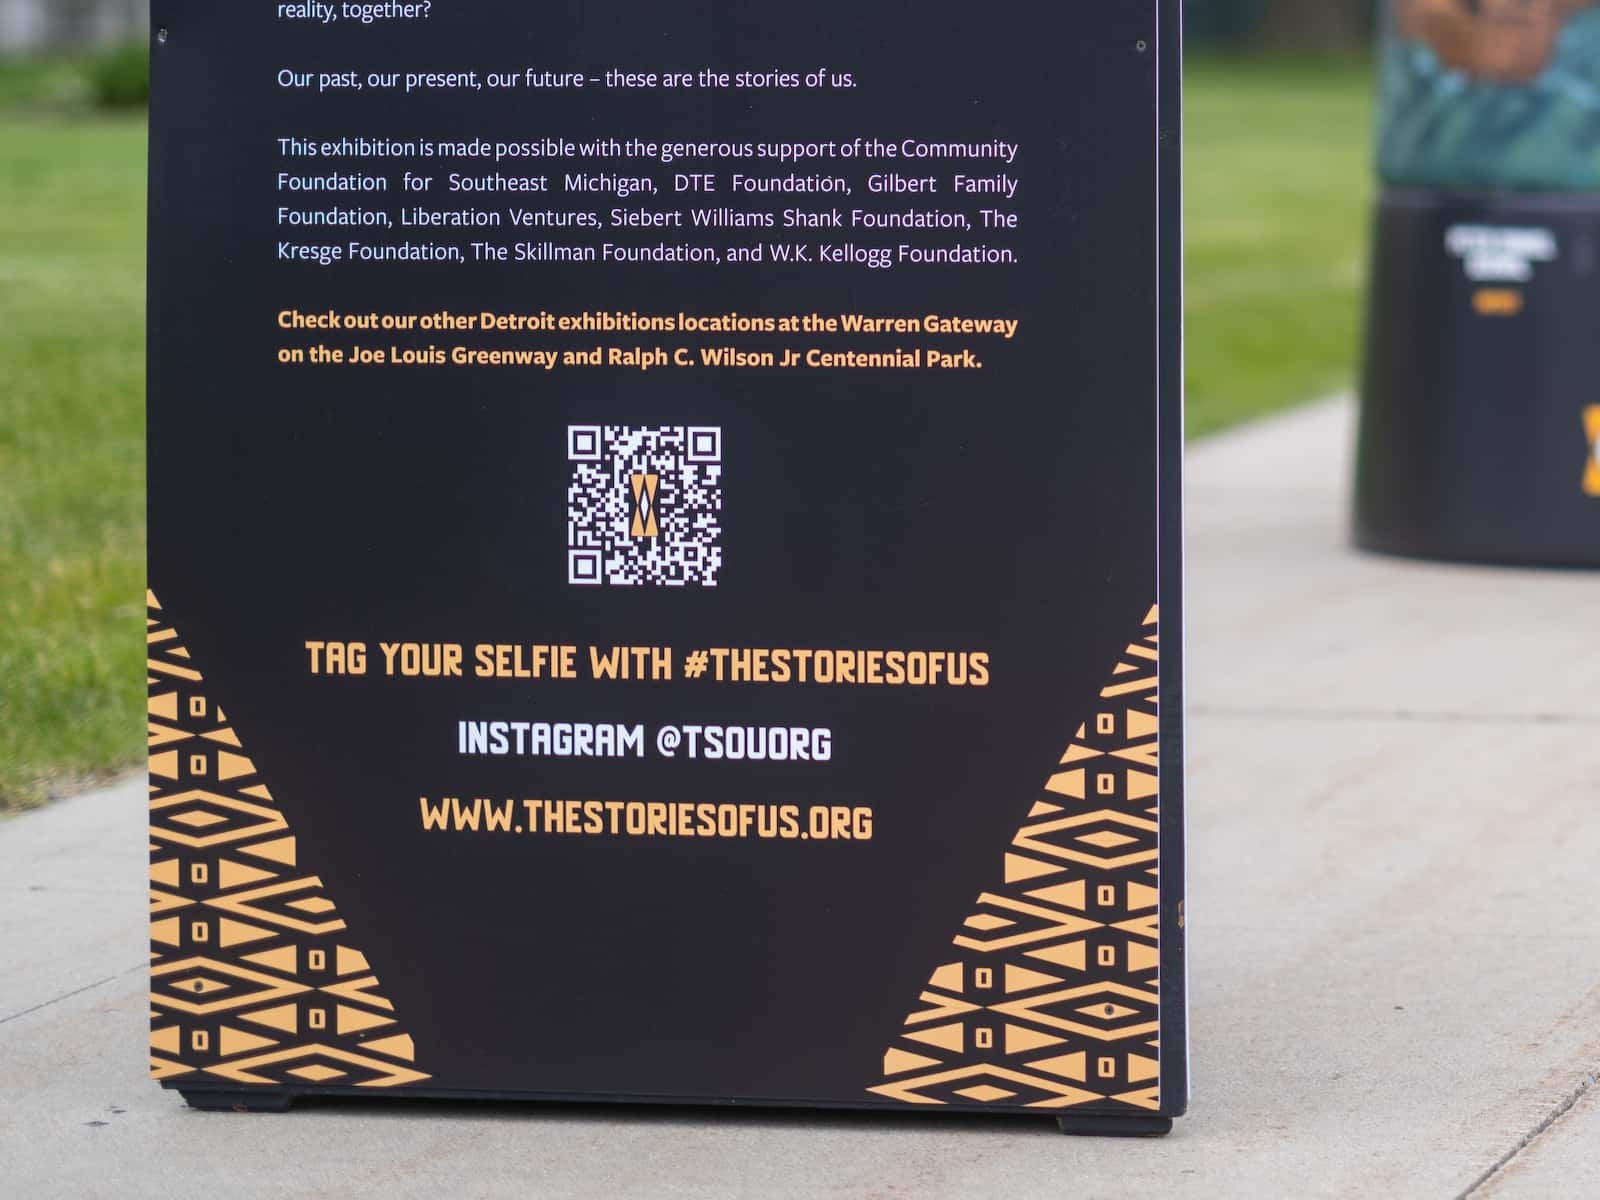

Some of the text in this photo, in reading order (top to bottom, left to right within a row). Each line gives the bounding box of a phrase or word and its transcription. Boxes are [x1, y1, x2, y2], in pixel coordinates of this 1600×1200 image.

[277, 136, 1020, 165] This exhibition is made possible with the generous support of the Community
[278, 171, 1019, 199] Foundation for Southeast Michigan, DTE Foundation, Gilbert Family
[278, 206, 1018, 232] Foundation, Liberation Ventures, Siebert Williams Shank Foundation, The
[278, 241, 1018, 269] Kresge Foundation, The Skillman Foundation, and W.K. Kellogg Foundation.
[277, 309, 1019, 339] Check out our other Detroit exhibitions locations at the Warren Gateway
[277, 344, 983, 371] on the Joe Louis Greenway and Ralph C. Wilson Jr Centennial Park.
[305, 640, 990, 686] TAG YOUR SELFIE WITH #THESTORIESOFUS
[458, 720, 832, 761] INSTAGRAM @TSOUORG
[419, 797, 873, 840] WWW.THESTORIESOFUS.ORG
